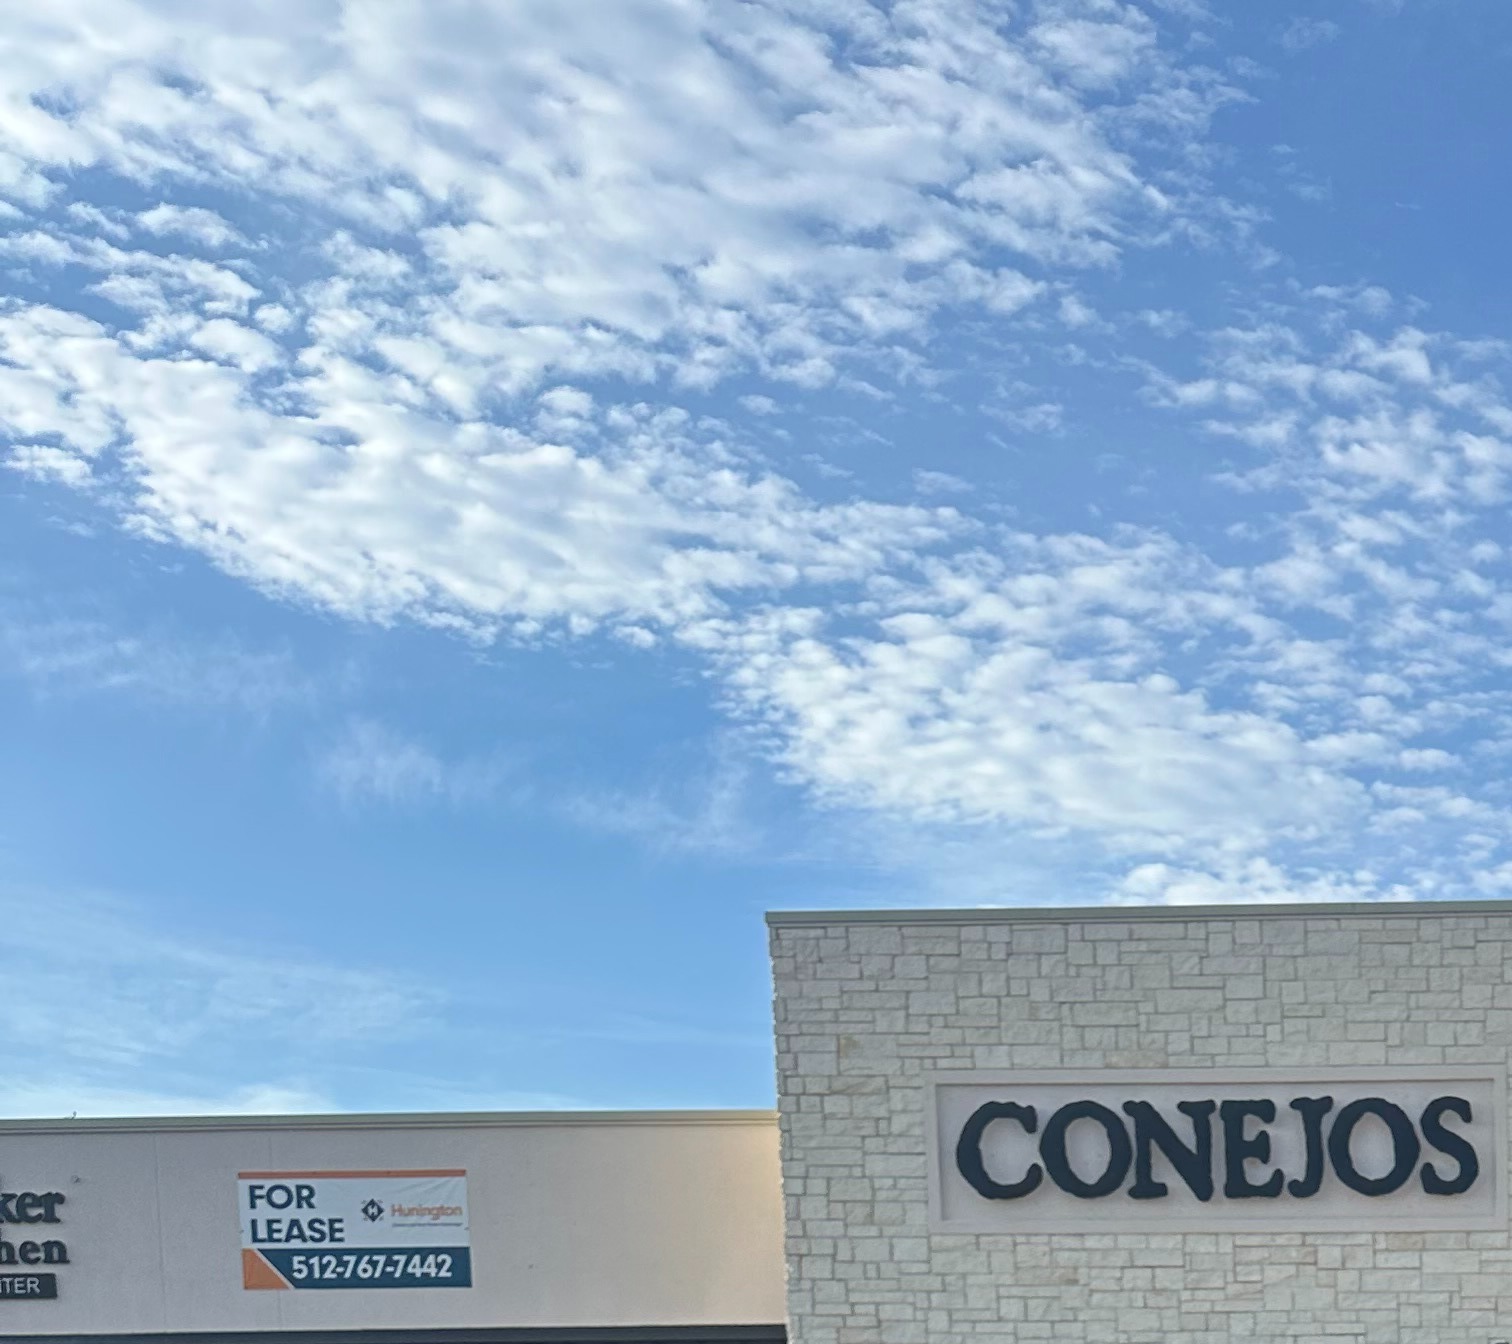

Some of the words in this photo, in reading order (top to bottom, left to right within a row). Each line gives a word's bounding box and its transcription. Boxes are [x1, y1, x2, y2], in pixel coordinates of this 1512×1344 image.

[956, 1096, 1479, 1201] CONEJOS
[249, 1184, 316, 1210] FOR
[251, 1217, 345, 1244] LEASE
[292, 1253, 453, 1280] 512-767-7442
[0, 1276, 41, 1294] TER
